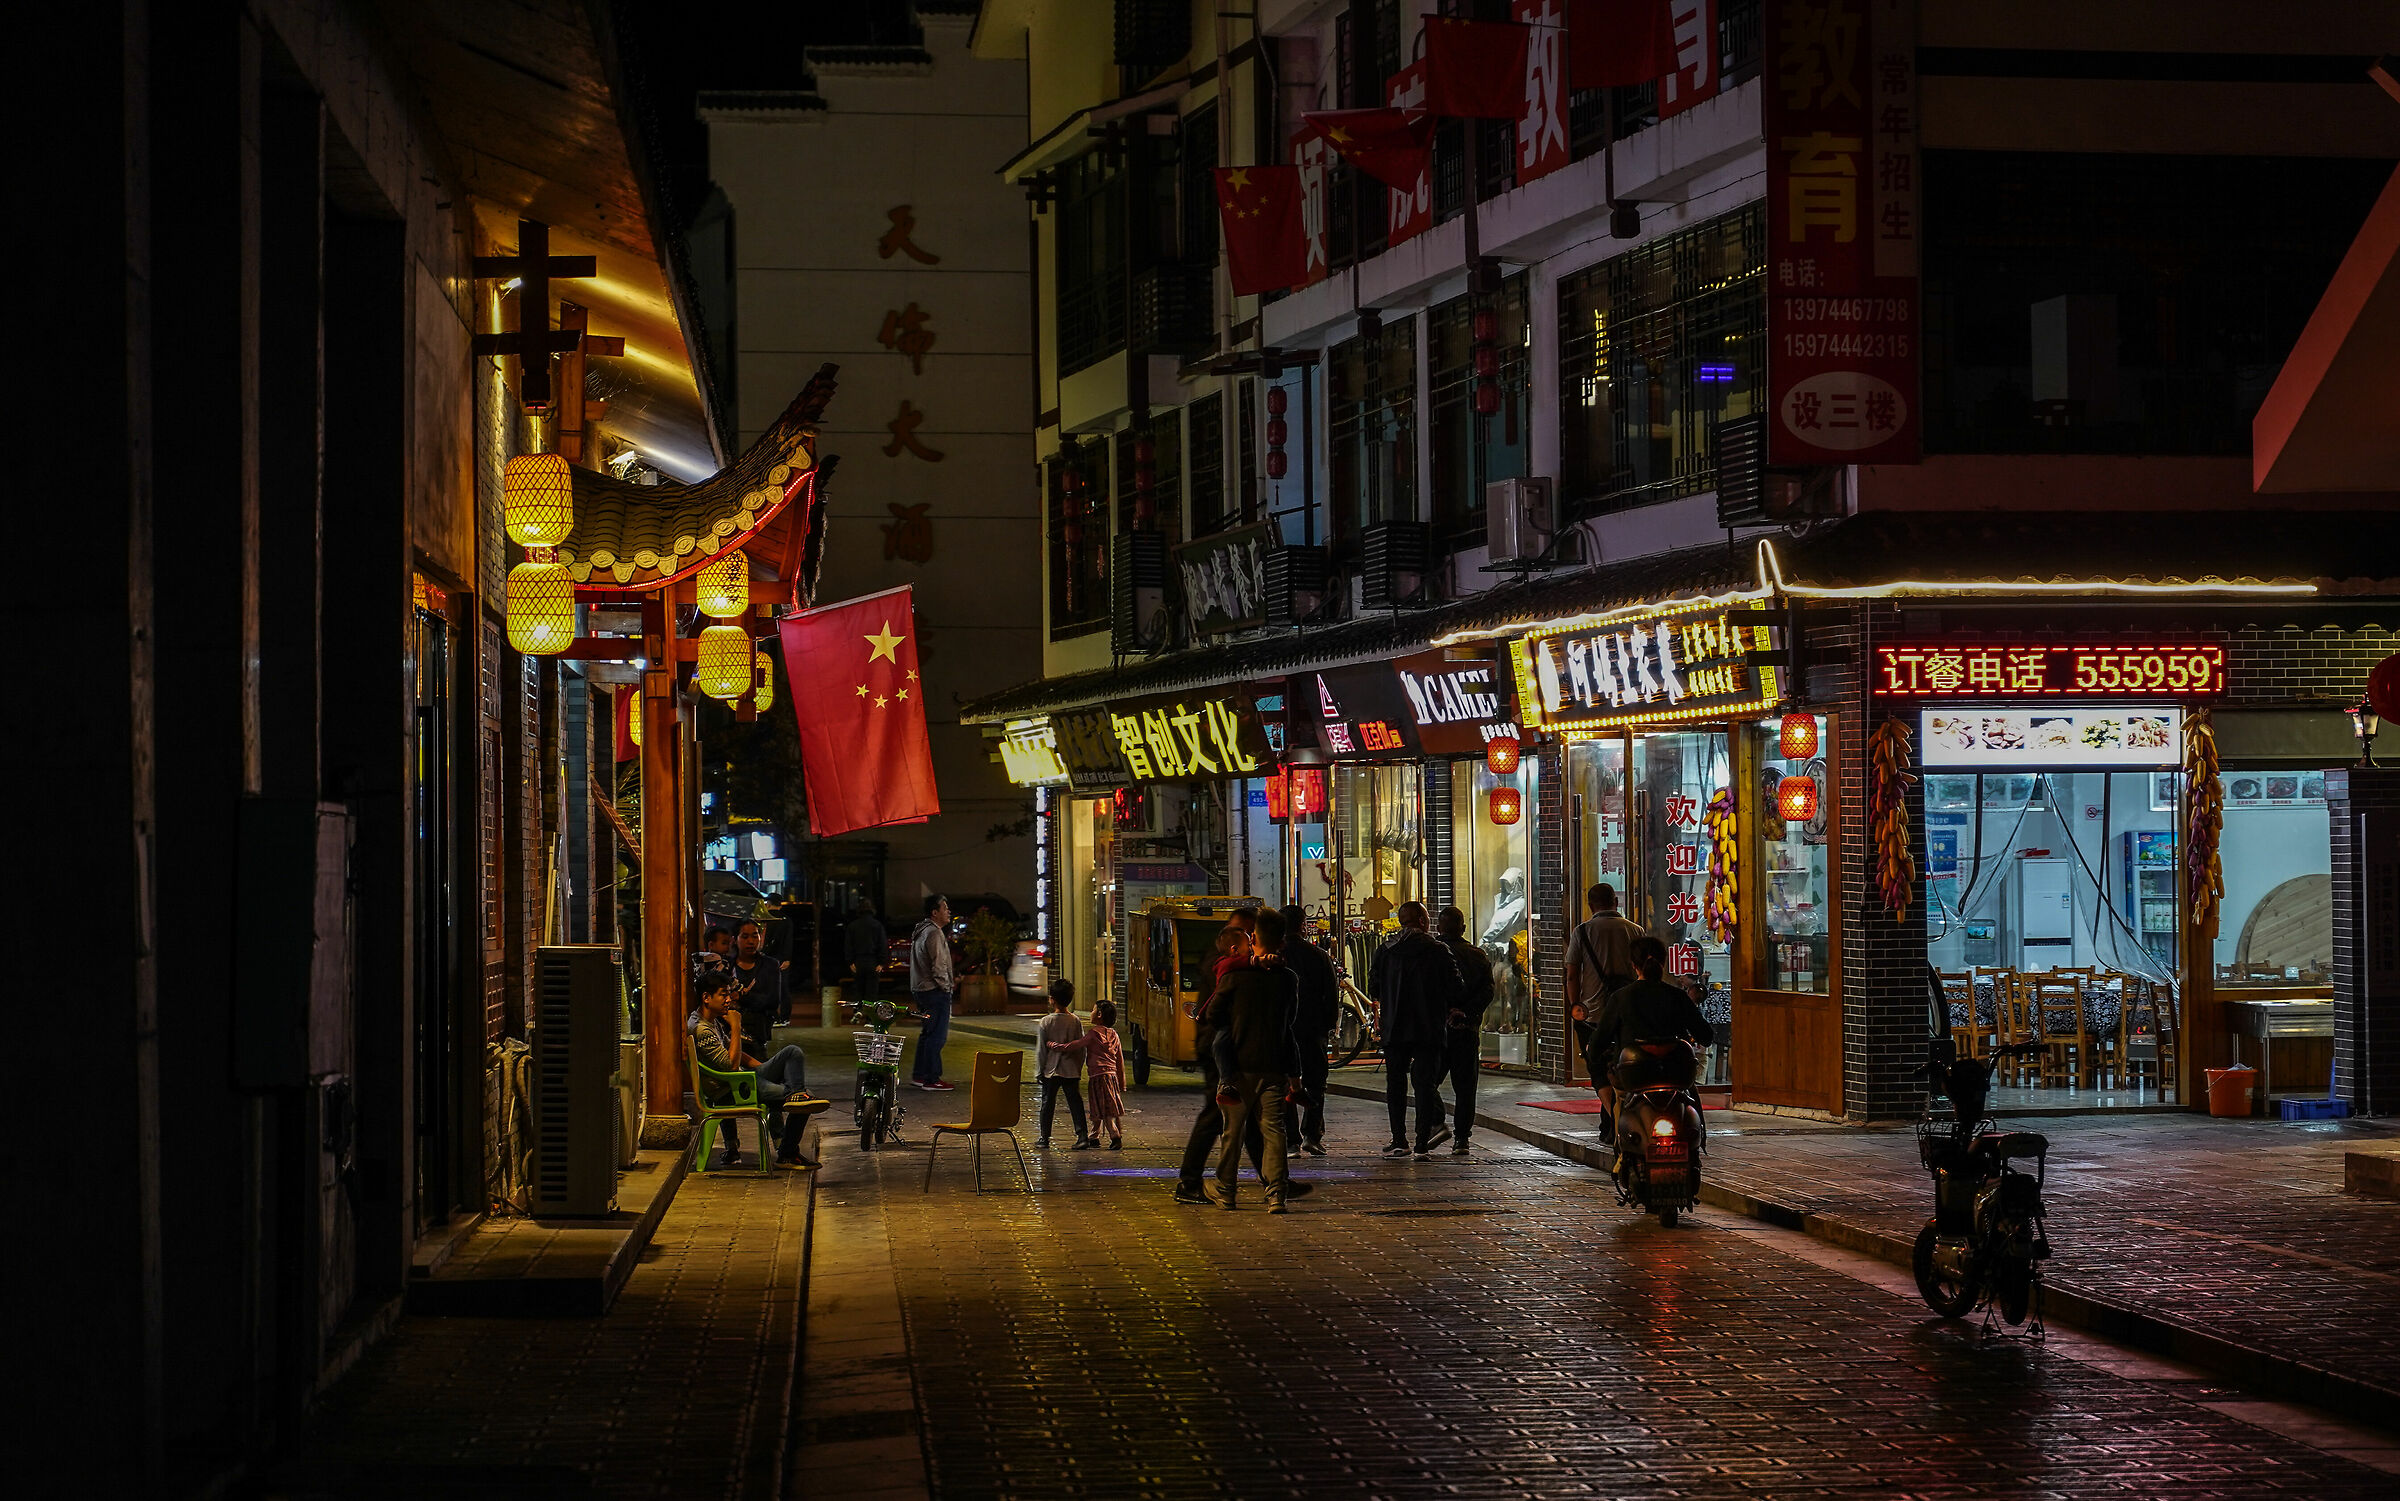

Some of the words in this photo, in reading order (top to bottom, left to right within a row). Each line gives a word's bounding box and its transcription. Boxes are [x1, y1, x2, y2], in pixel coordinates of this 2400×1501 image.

[1879, 53, 1912, 241] 常年招生
[1784, 297, 1909, 322] 13974467798
[1784, 334, 1909, 358] 15974442315
[1792, 391, 1896, 430] 设三楼
[1883, 652, 2047, 690] 订餐电话
[2076, 655, 2211, 689] 555959
[1111, 700, 1258, 780] 智创文化
[1666, 794, 1699, 976] 欢迎光临
[1303, 903, 1366, 918] CAE
